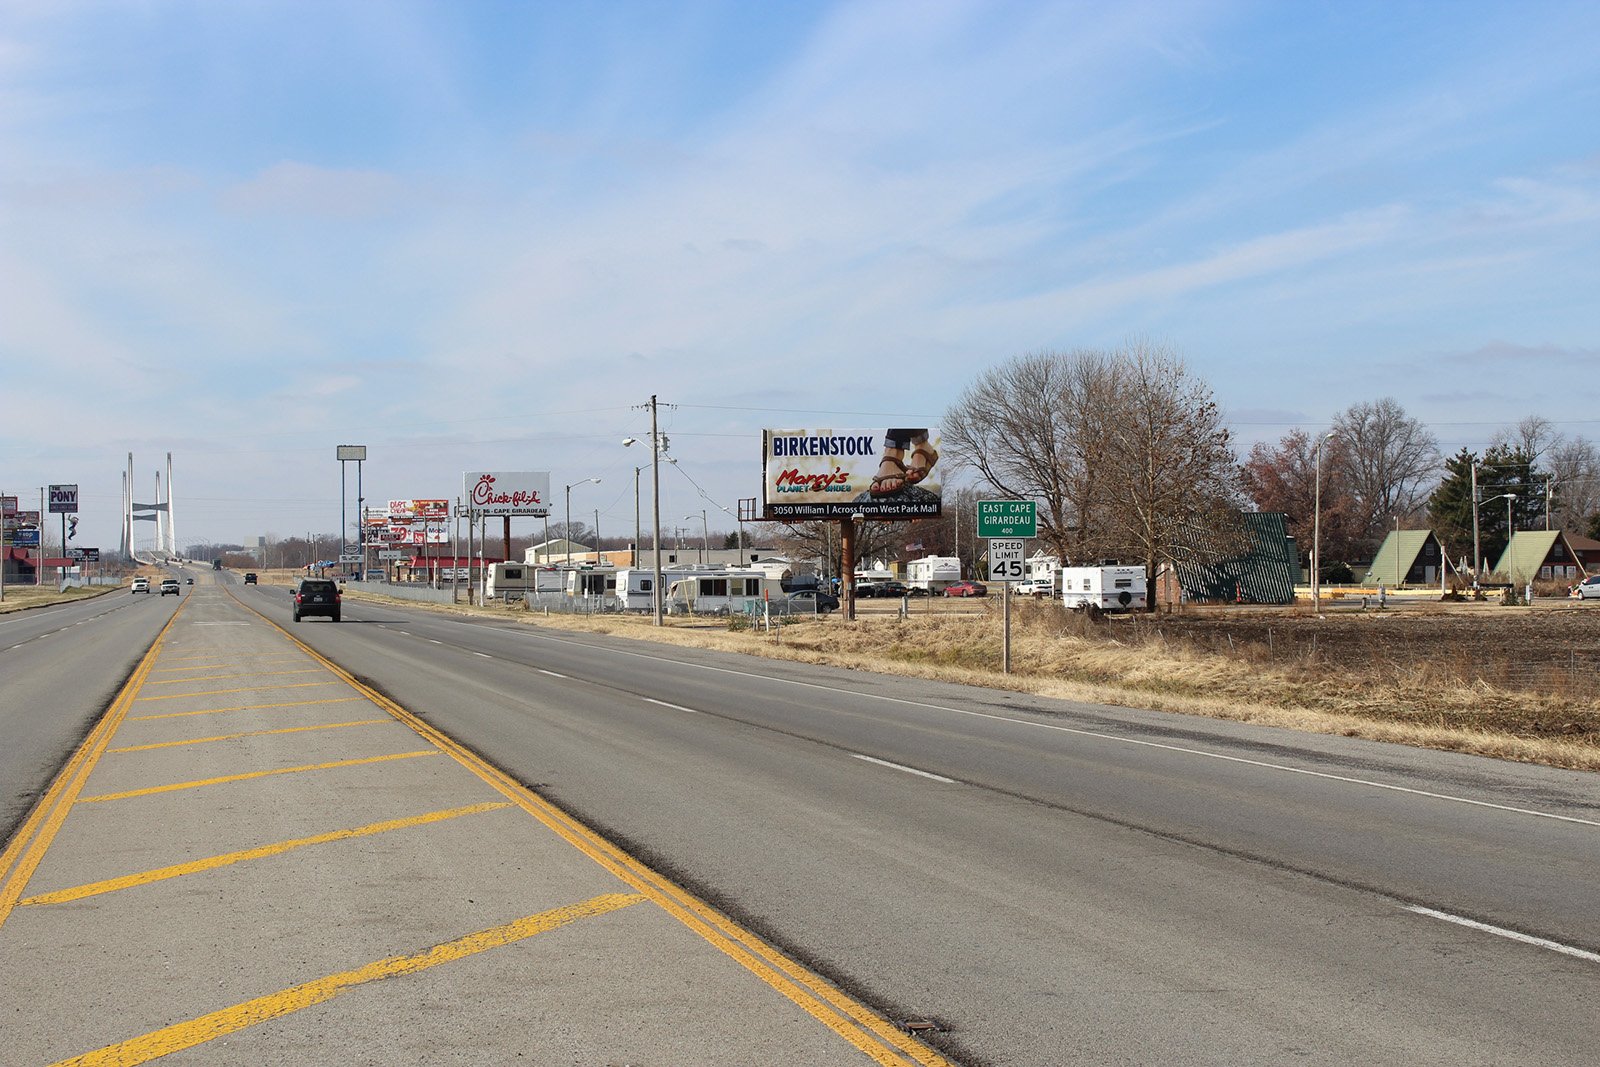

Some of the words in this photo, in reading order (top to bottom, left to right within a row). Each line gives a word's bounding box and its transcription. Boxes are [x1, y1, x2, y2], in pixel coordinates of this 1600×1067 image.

[773, 436, 873, 457] BIRKENSTOCK
[775, 466, 850, 490] Marcy's
[472, 477, 541, 507] Chick-fil-A
[776, 485, 810, 493] PLANET
[824, 485, 852, 493] SHOES
[50, 491, 76, 502] PONY
[773, 505, 794, 515] 3050
[794, 505, 825, 515] William
[831, 504, 858, 514] Across
[859, 504, 878, 514] from
[879, 504, 900, 514] West
[901, 504, 919, 514] Park
[920, 504, 937, 513] Mall
[983, 504, 1004, 513] EAST
[1009, 504, 1031, 513] CAPE
[984, 516, 1031, 525] GIRARDEAU
[992, 542, 1023, 550] SPEED
[992, 561, 1022, 577] 45
